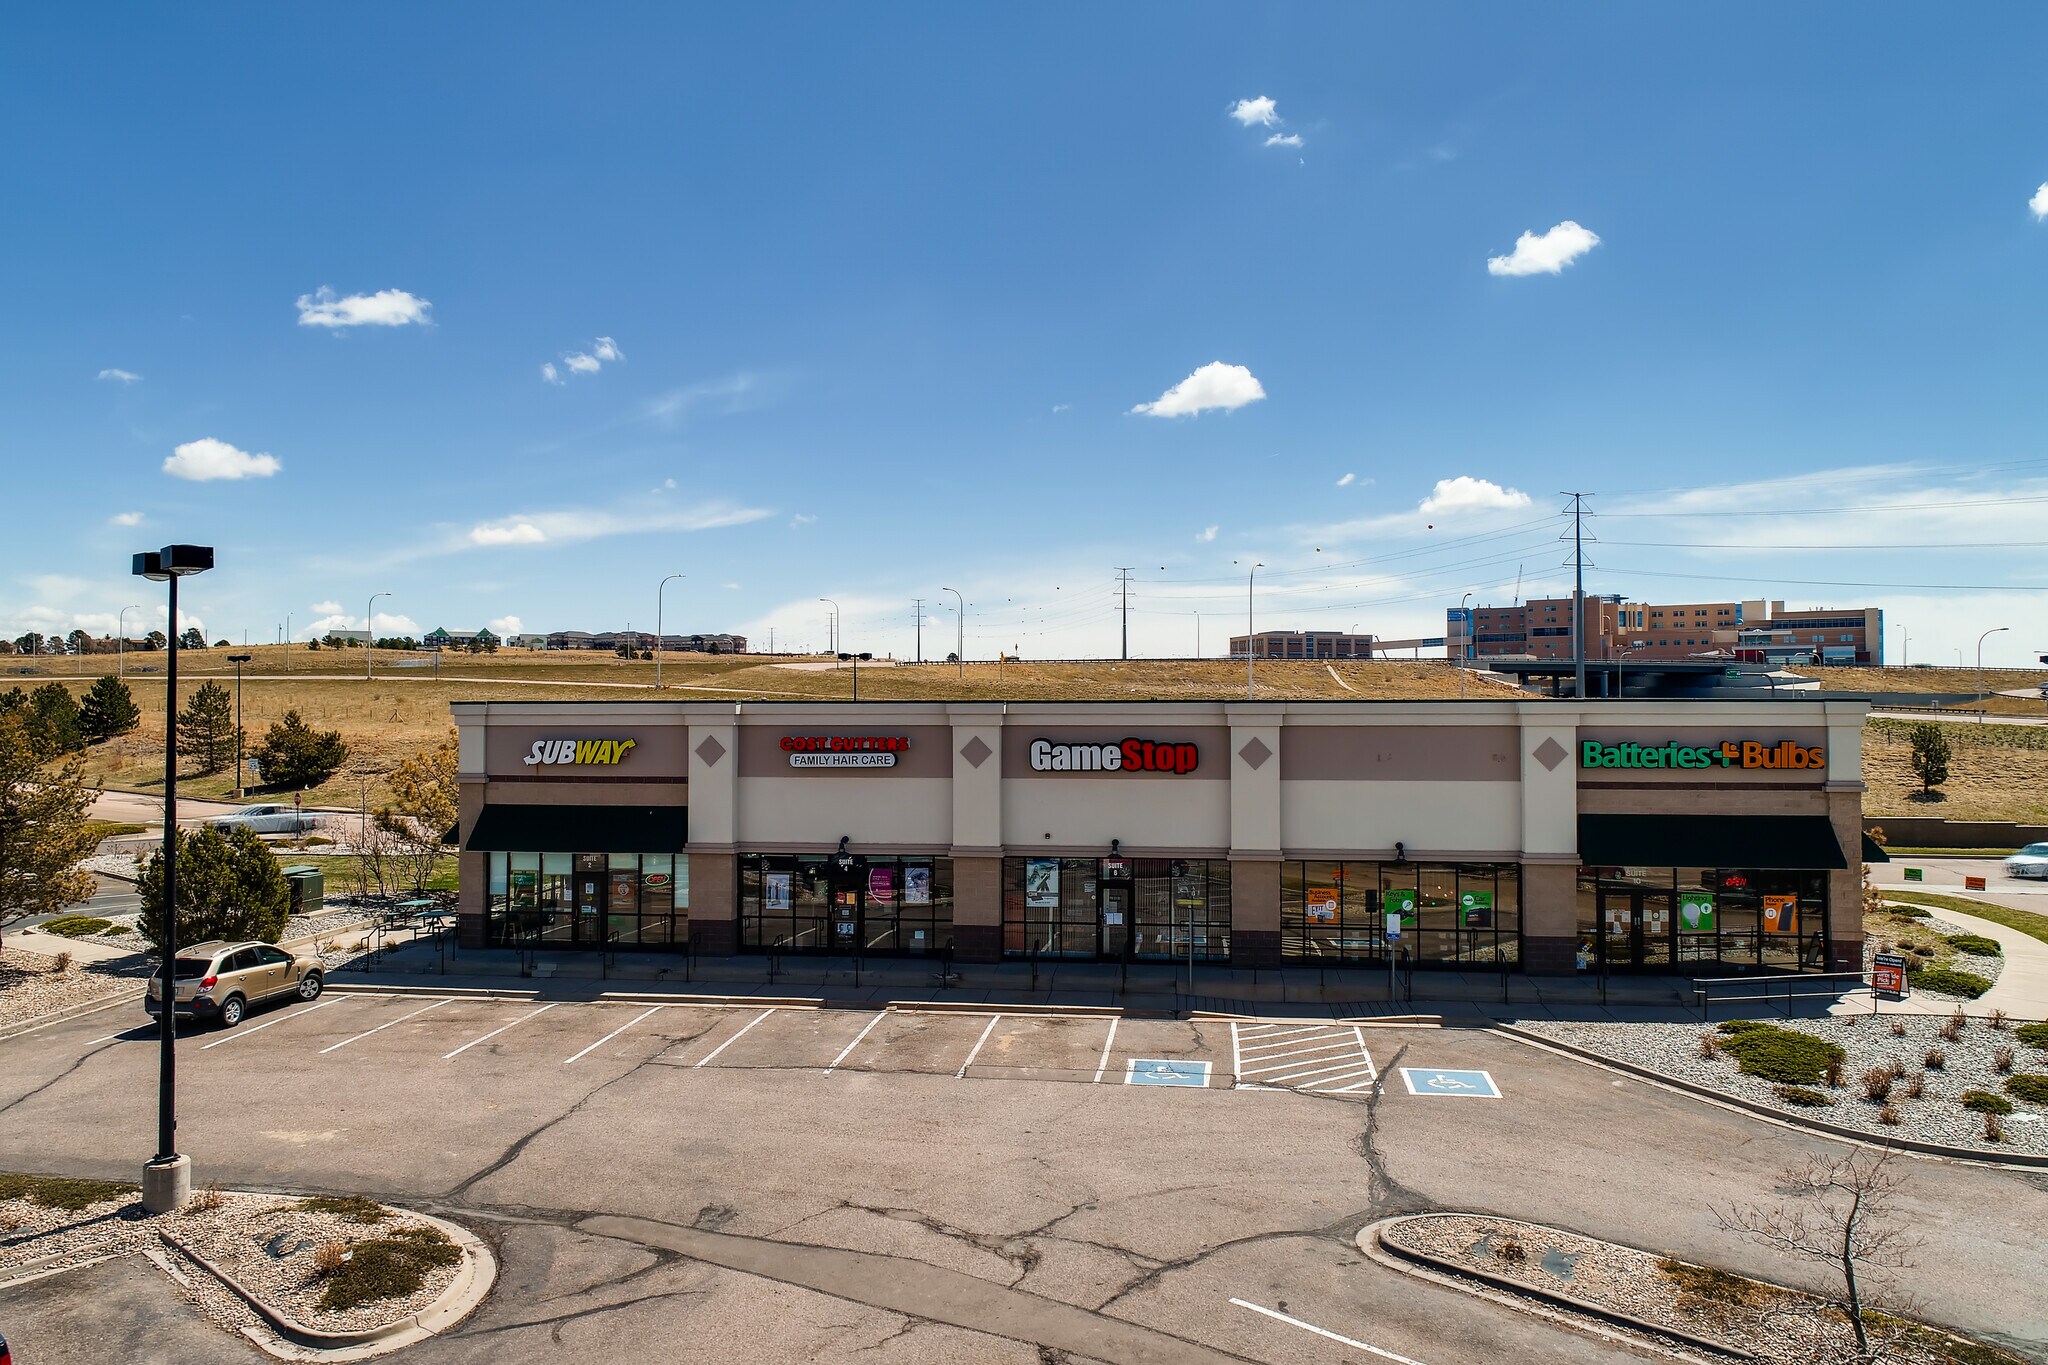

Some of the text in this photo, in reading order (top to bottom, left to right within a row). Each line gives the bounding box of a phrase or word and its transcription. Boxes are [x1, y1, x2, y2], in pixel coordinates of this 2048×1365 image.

[780, 737, 910, 751] COST CUTTERS
[523, 739, 636, 765] SUBWAY
[1030, 738, 1198, 774] GameStop
[1583, 741, 1711, 768] Batteries
[1742, 741, 1825, 768] Bulbs
[794, 755, 891, 765] FAMILY HAIR CARE
[838, 858, 854, 866] SUITE
[1725, 877, 1747, 886] OPEN
[1385, 890, 1400, 898] Keys
[1682, 894, 1707, 902] Lighting
